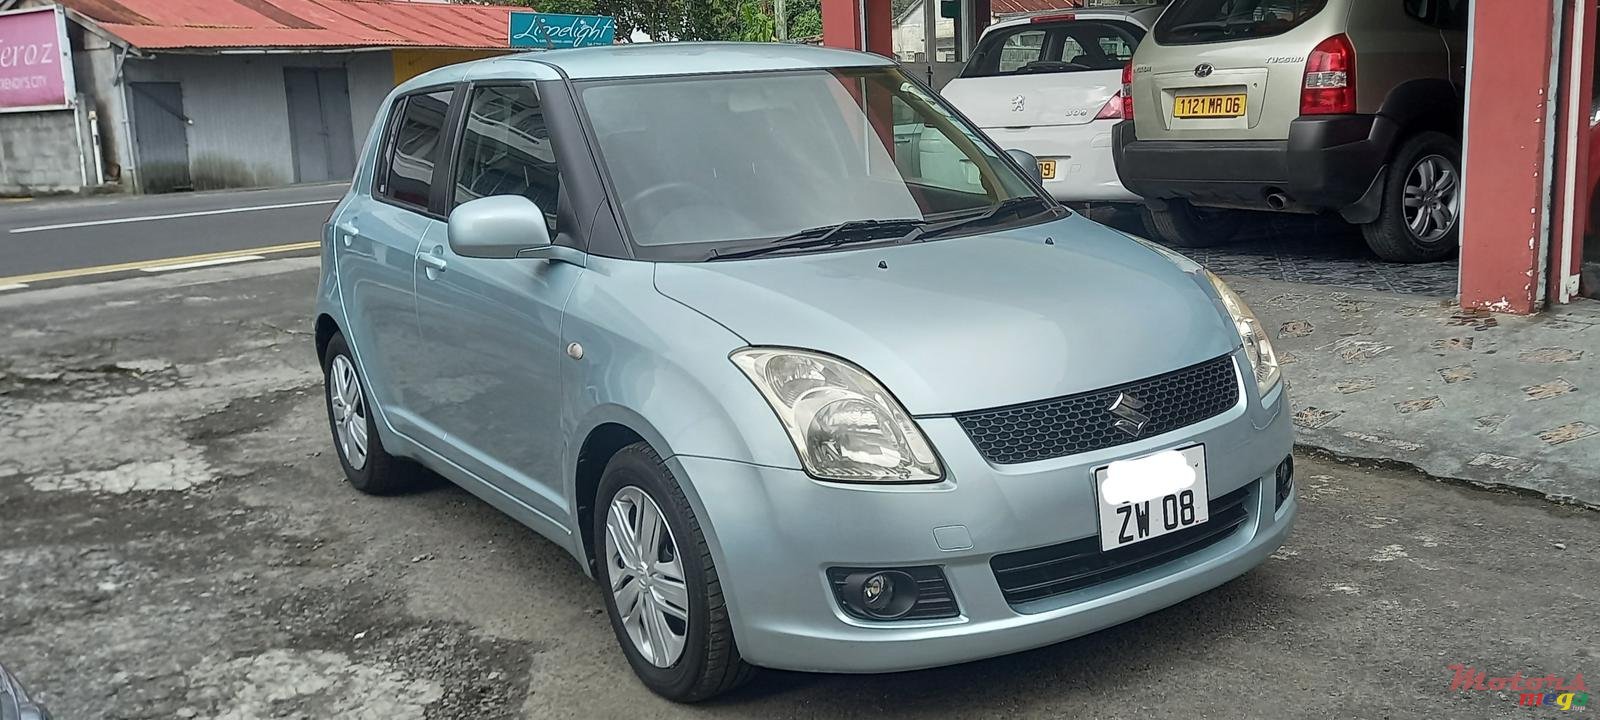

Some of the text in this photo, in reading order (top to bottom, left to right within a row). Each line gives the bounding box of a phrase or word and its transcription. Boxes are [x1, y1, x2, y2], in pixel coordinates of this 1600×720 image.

[513, 15, 613, 48] Limelight
[0, 39, 53, 68] eroz
[1180, 96, 1240, 114] 1121 MR 06
[1116, 489, 1195, 544] ZW 08
